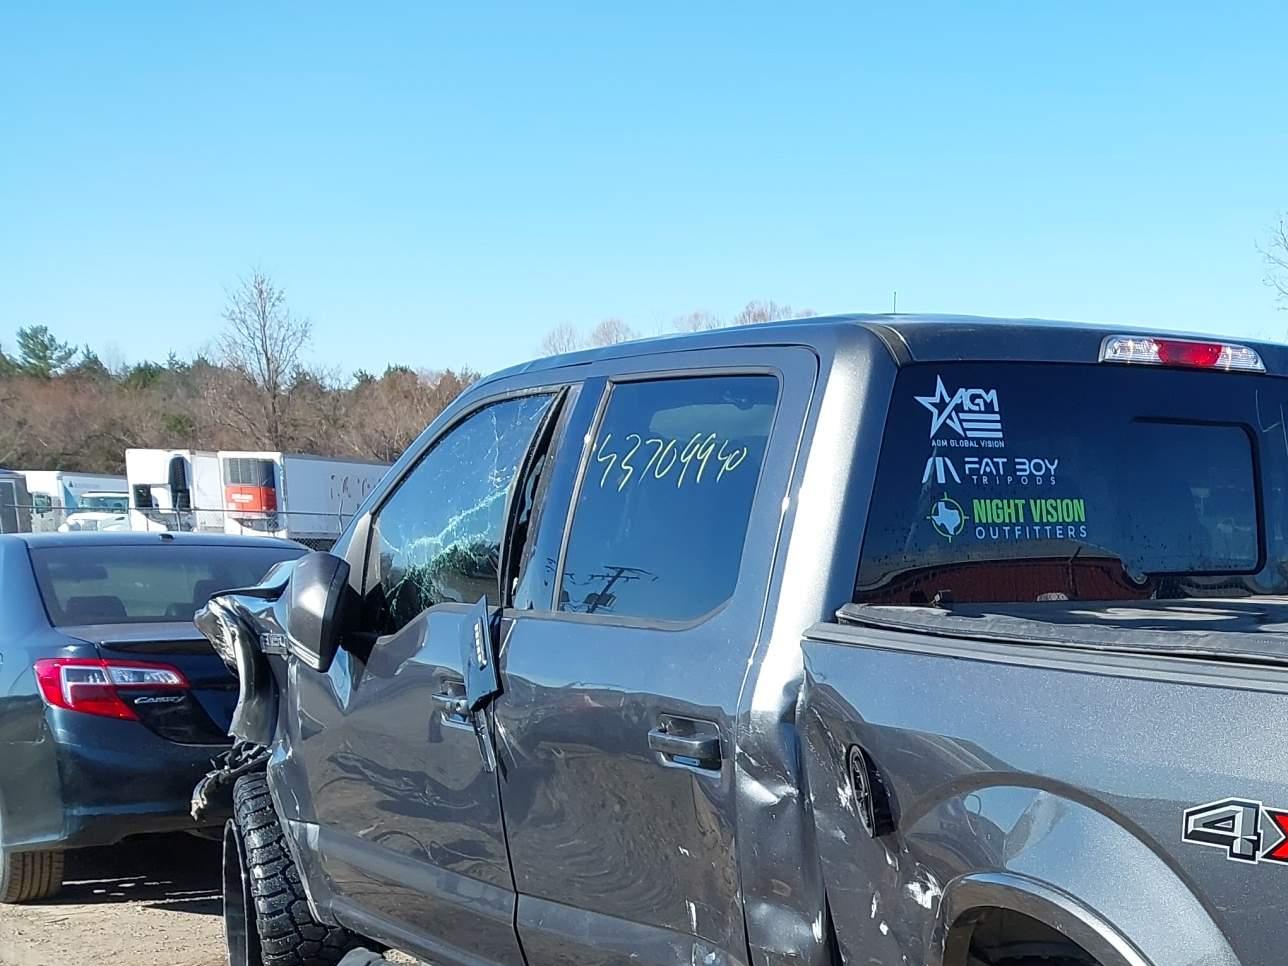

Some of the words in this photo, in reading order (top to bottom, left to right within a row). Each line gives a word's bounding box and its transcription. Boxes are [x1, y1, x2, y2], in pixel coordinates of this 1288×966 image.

[951, 387, 1000, 412] AGM
[950, 439, 979, 448] GLOBAL
[980, 439, 1005, 448] VISION
[597, 432, 748, 493] 43709940
[964, 457, 1008, 476] FAT
[1014, 457, 1059, 476] BOY
[971, 475, 1056, 486] TRIPODS
[972, 499, 1026, 524] NIGHT
[1029, 499, 1086, 523] VISION
[975, 525, 1088, 540] OUTFITTERS
